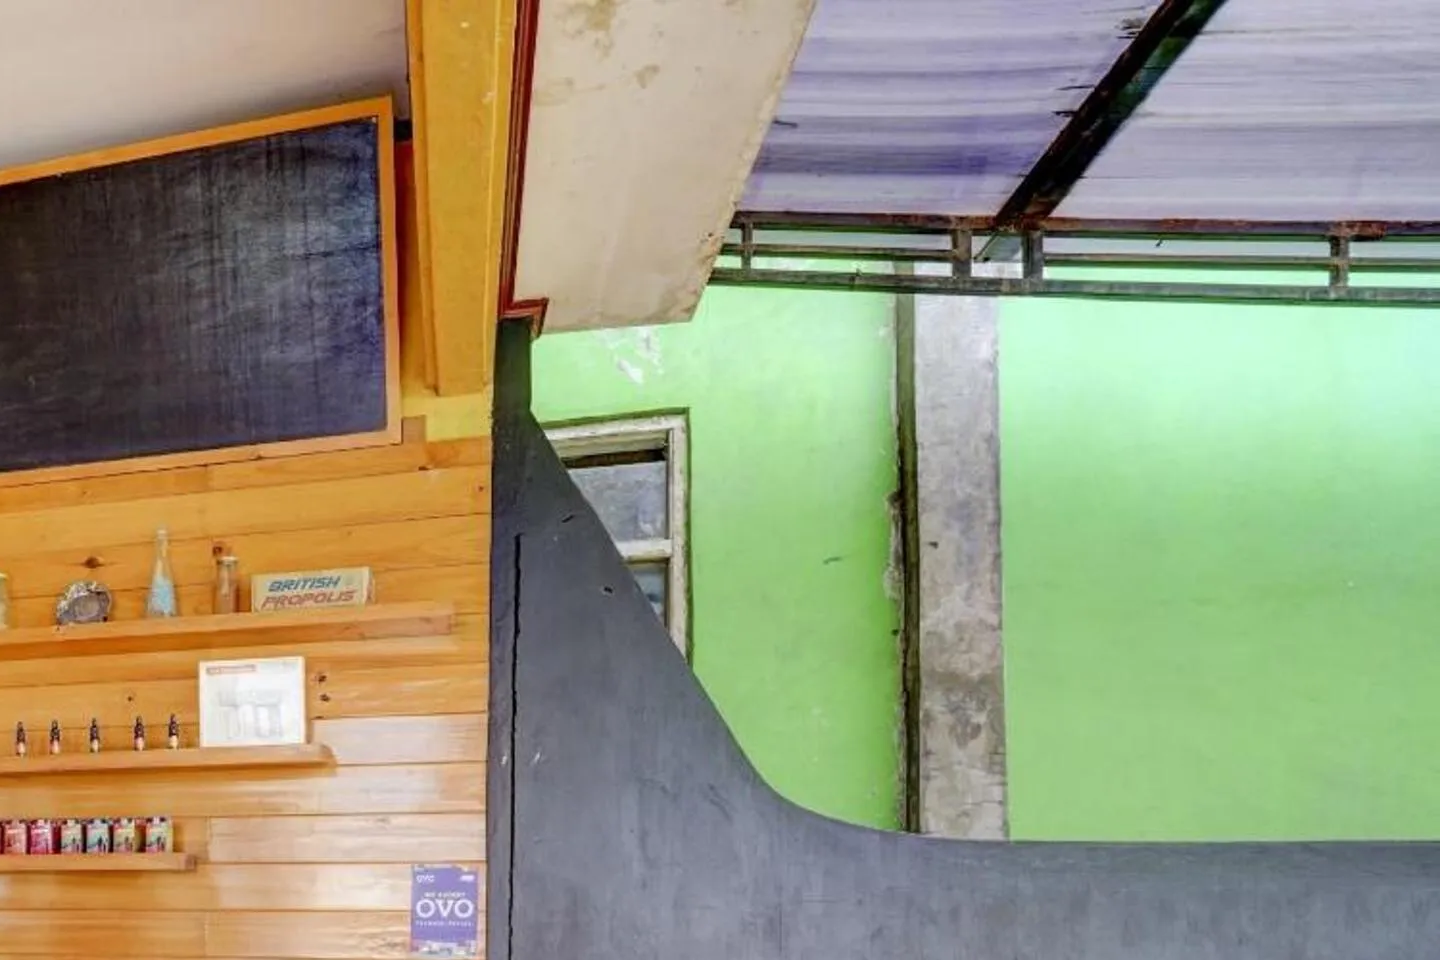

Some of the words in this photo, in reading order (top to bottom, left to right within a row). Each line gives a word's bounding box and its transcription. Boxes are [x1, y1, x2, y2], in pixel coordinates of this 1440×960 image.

[268, 576, 341, 592] BRITISH
[261, 589, 357, 610] PROPOLIS
[416, 899, 474, 918] OVO
